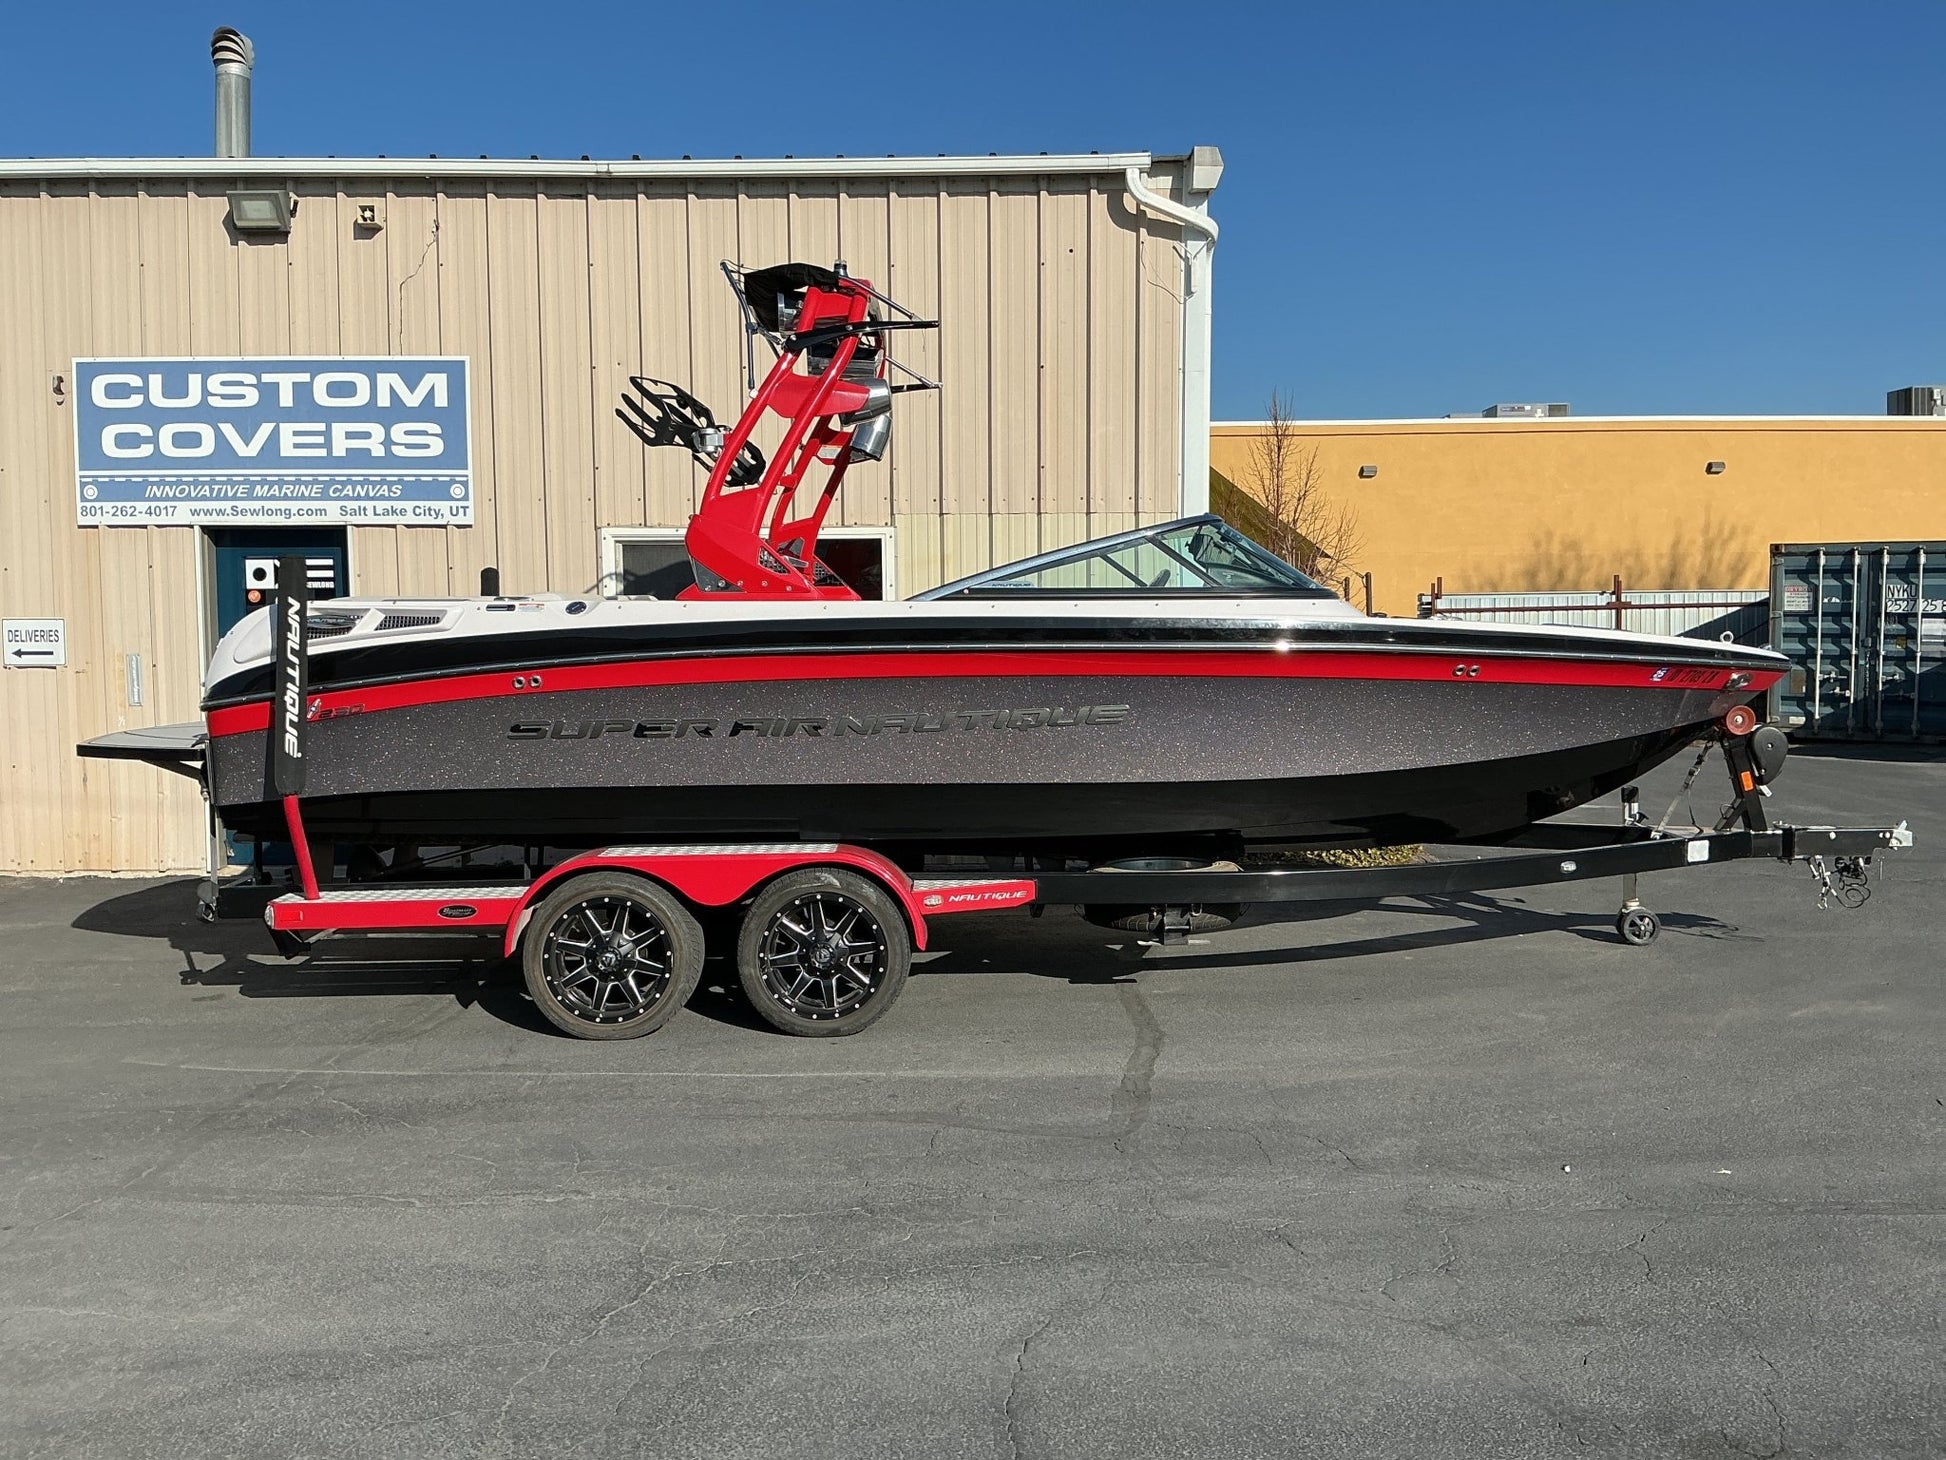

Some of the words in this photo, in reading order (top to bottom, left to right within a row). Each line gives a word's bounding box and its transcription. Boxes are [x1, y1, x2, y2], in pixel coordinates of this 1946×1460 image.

[91, 372, 449, 409] CUSTOM
[101, 422, 445, 459] COVERS
[145, 485, 249, 498] INNOVATIVE
[253, 484, 324, 498] MARINE
[329, 484, 402, 497] CANVAS
[80, 505, 178, 518] 801-262-4017
[189, 505, 328, 520] www.Sewlong.com
[339, 505, 368, 518] Salt
[373, 505, 408, 517] Lake
[412, 505, 445, 519] City,
[449, 505, 470, 517] UT
[1887, 585, 1917, 598] NYKU
[7, 629, 60, 643] DELIVERIES
[284, 596, 302, 759] NAUTIQUE
[506, 718, 718, 740] SUPER
[729, 717, 825, 738] AIR
[833, 704, 1131, 738] NAUTIQUE
[948, 891, 1028, 902] NAUTIQUE
